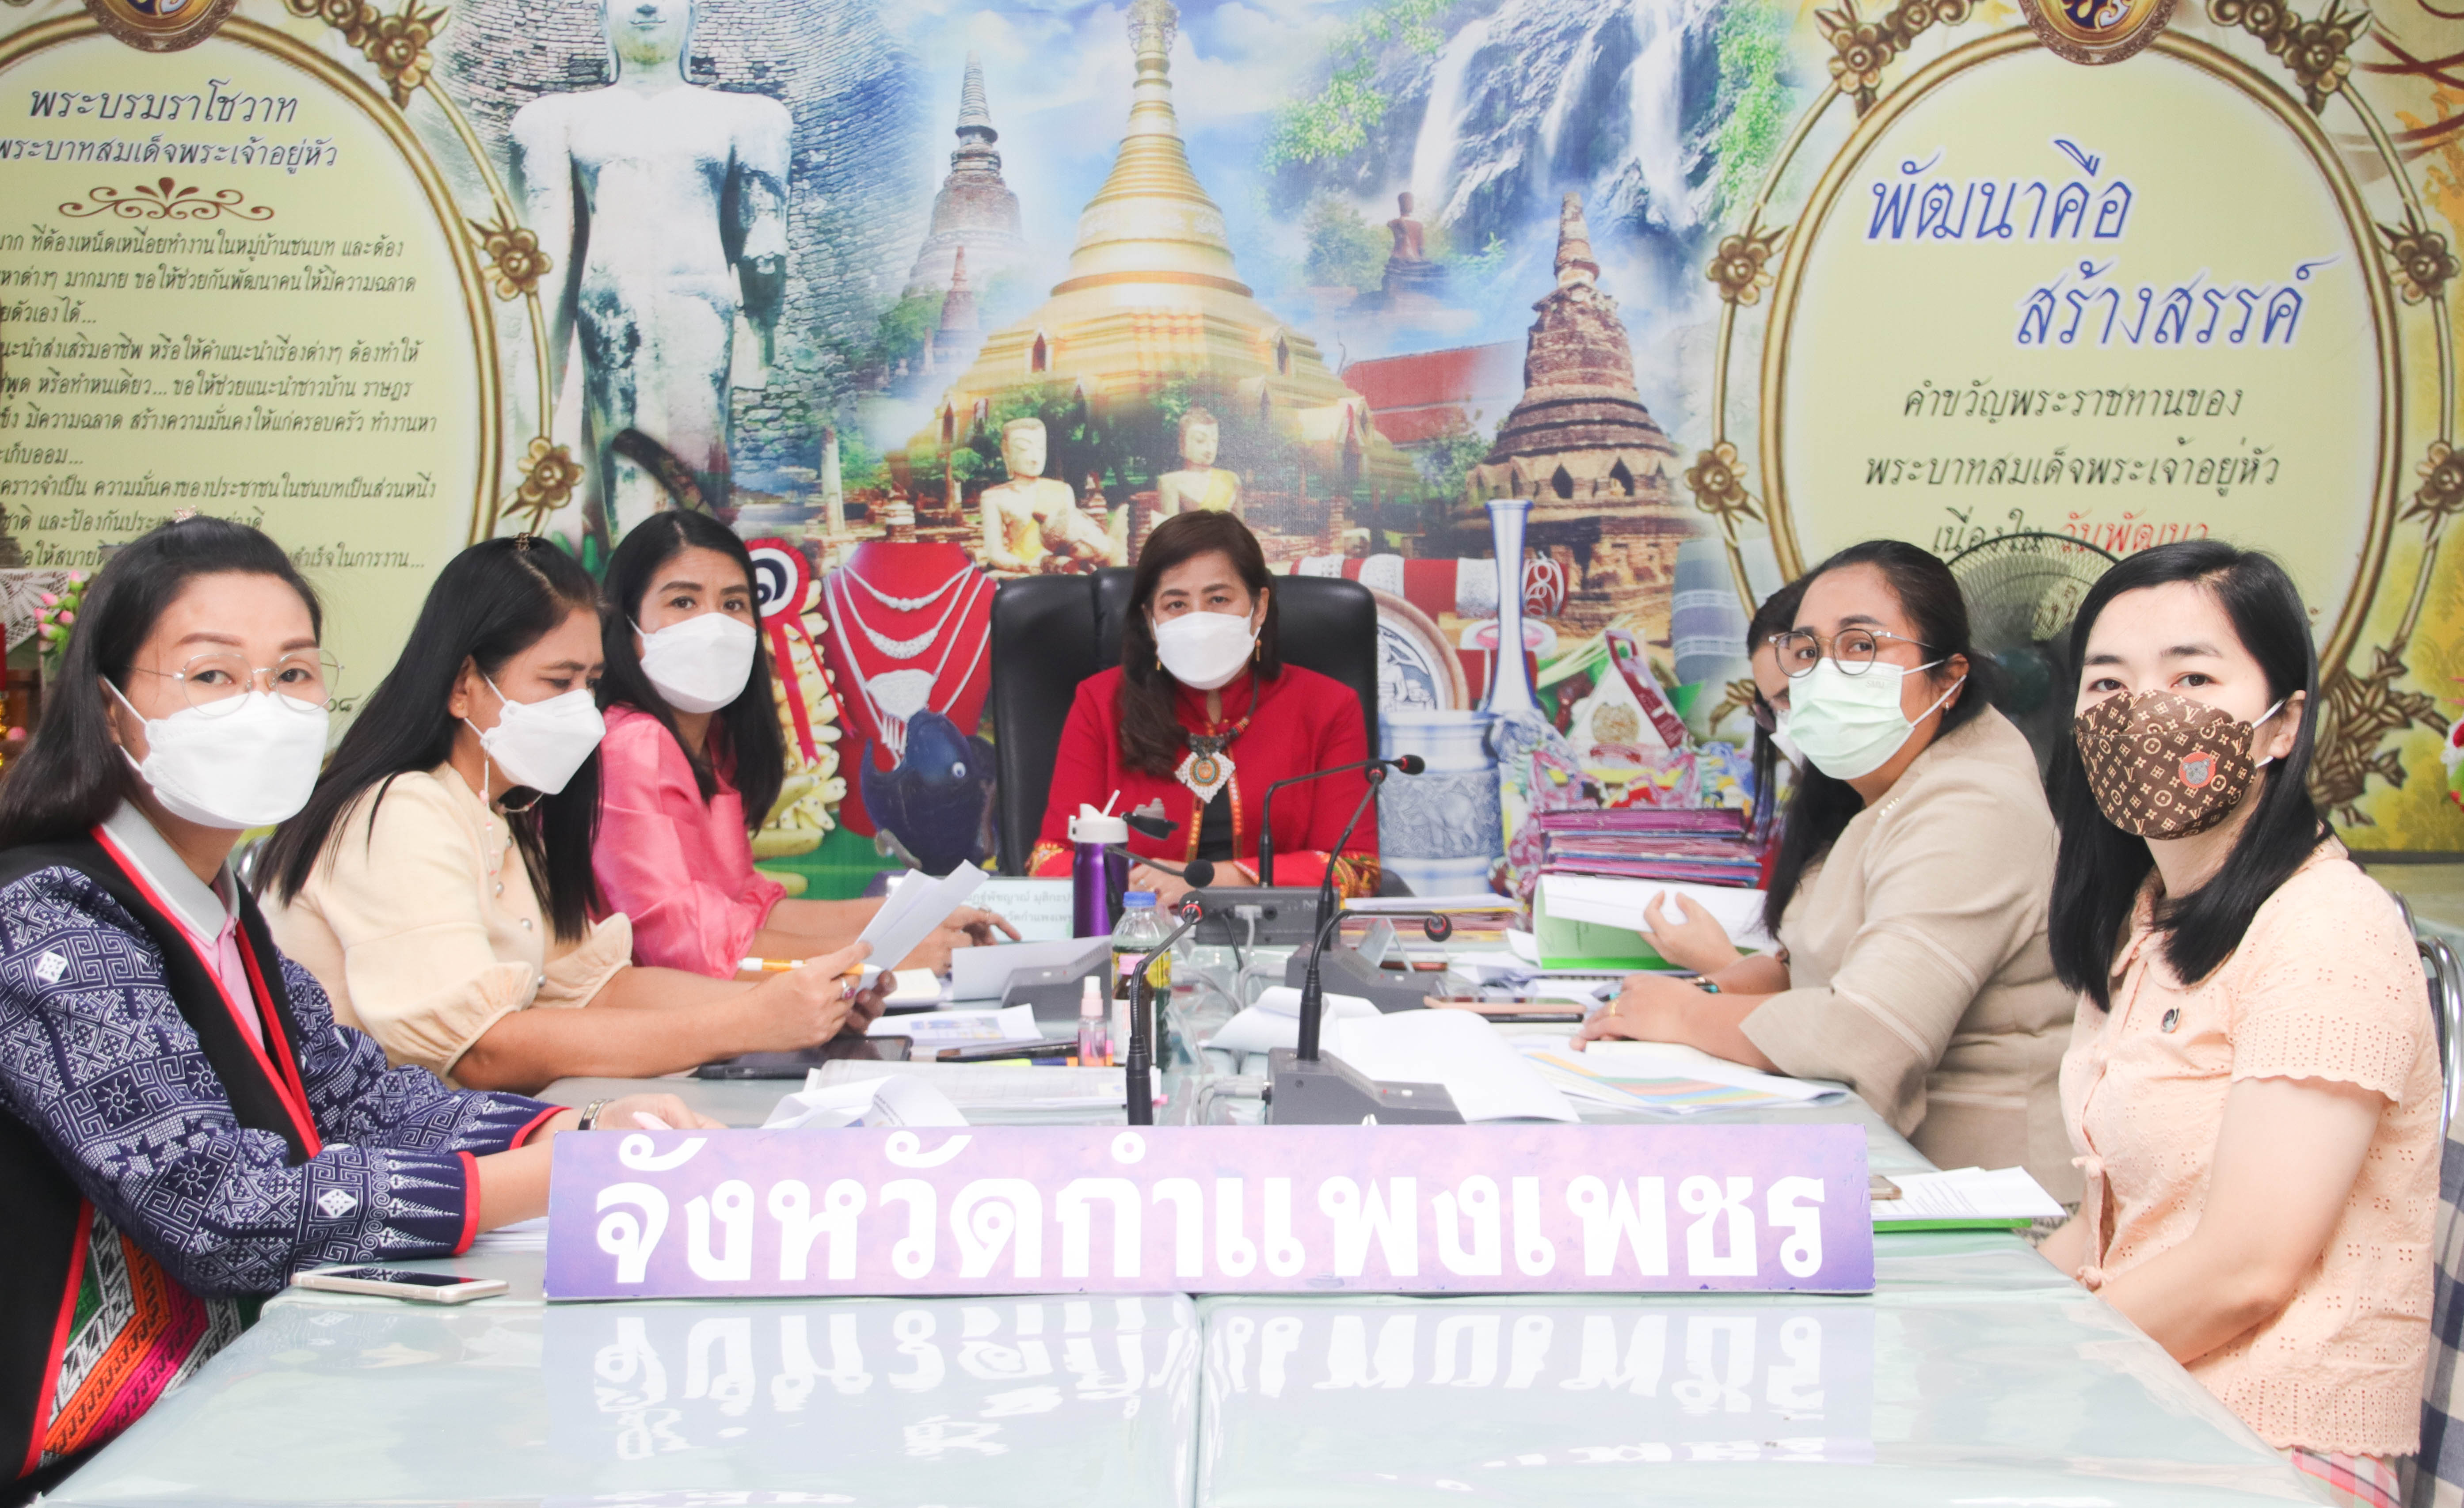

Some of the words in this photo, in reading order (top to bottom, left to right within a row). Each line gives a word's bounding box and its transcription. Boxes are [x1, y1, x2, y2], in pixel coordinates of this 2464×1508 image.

[29, 79, 298, 122] พระบรมราโชวาท
[1867, 139, 2133, 239] พัฒนาคือ
[342, 233, 404, 257] และต้อง
[0, 266, 57, 290] หาต่างๆ
[65, 271, 129, 288] มากมาย
[2017, 256, 2341, 344] สร้างสรรค์
[349, 336, 425, 362] ต้องทำให้
[363, 381, 414, 401] ราษฎร
[1903, 374, 2243, 424] คำขวัญพระราชทานของ
[25, 402, 123, 429] มีความฉลาด
[371, 410, 437, 432] ทำงานหา
[1865, 437, 2280, 497] พระบาทสมเด็จพระเจ้าอยู่หัว
[594, 1128, 1828, 1284] จังหวัดกำแพงเพชร
